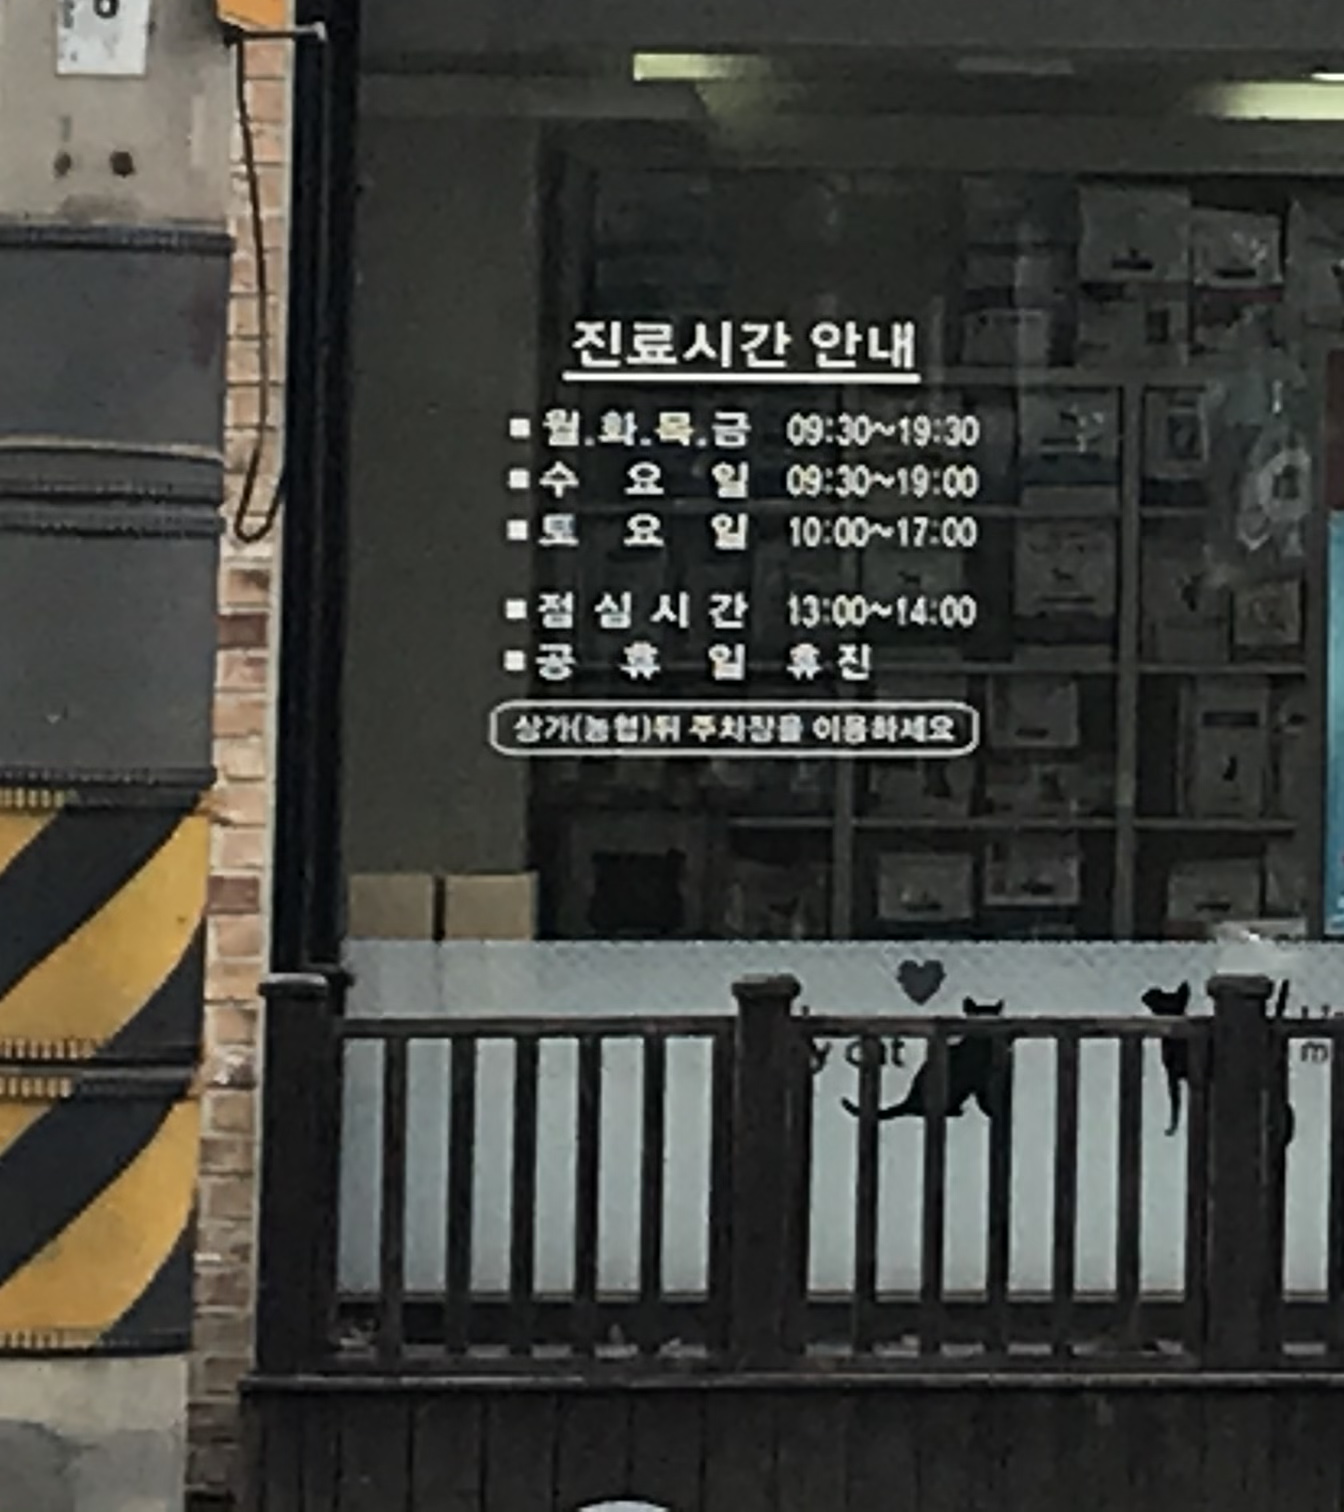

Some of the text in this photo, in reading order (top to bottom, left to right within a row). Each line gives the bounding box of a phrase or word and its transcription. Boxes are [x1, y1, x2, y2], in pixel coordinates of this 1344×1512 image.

[572, 320, 916, 369] 진료시간 안내
[786, 413, 981, 447] 09:30~19:30
[786, 463, 980, 498] 09:30~19:00
[788, 515, 979, 548] 10:00~17:00
[786, 594, 978, 629] 13:00~14:00
[812, 714, 957, 745] 이용하세요
